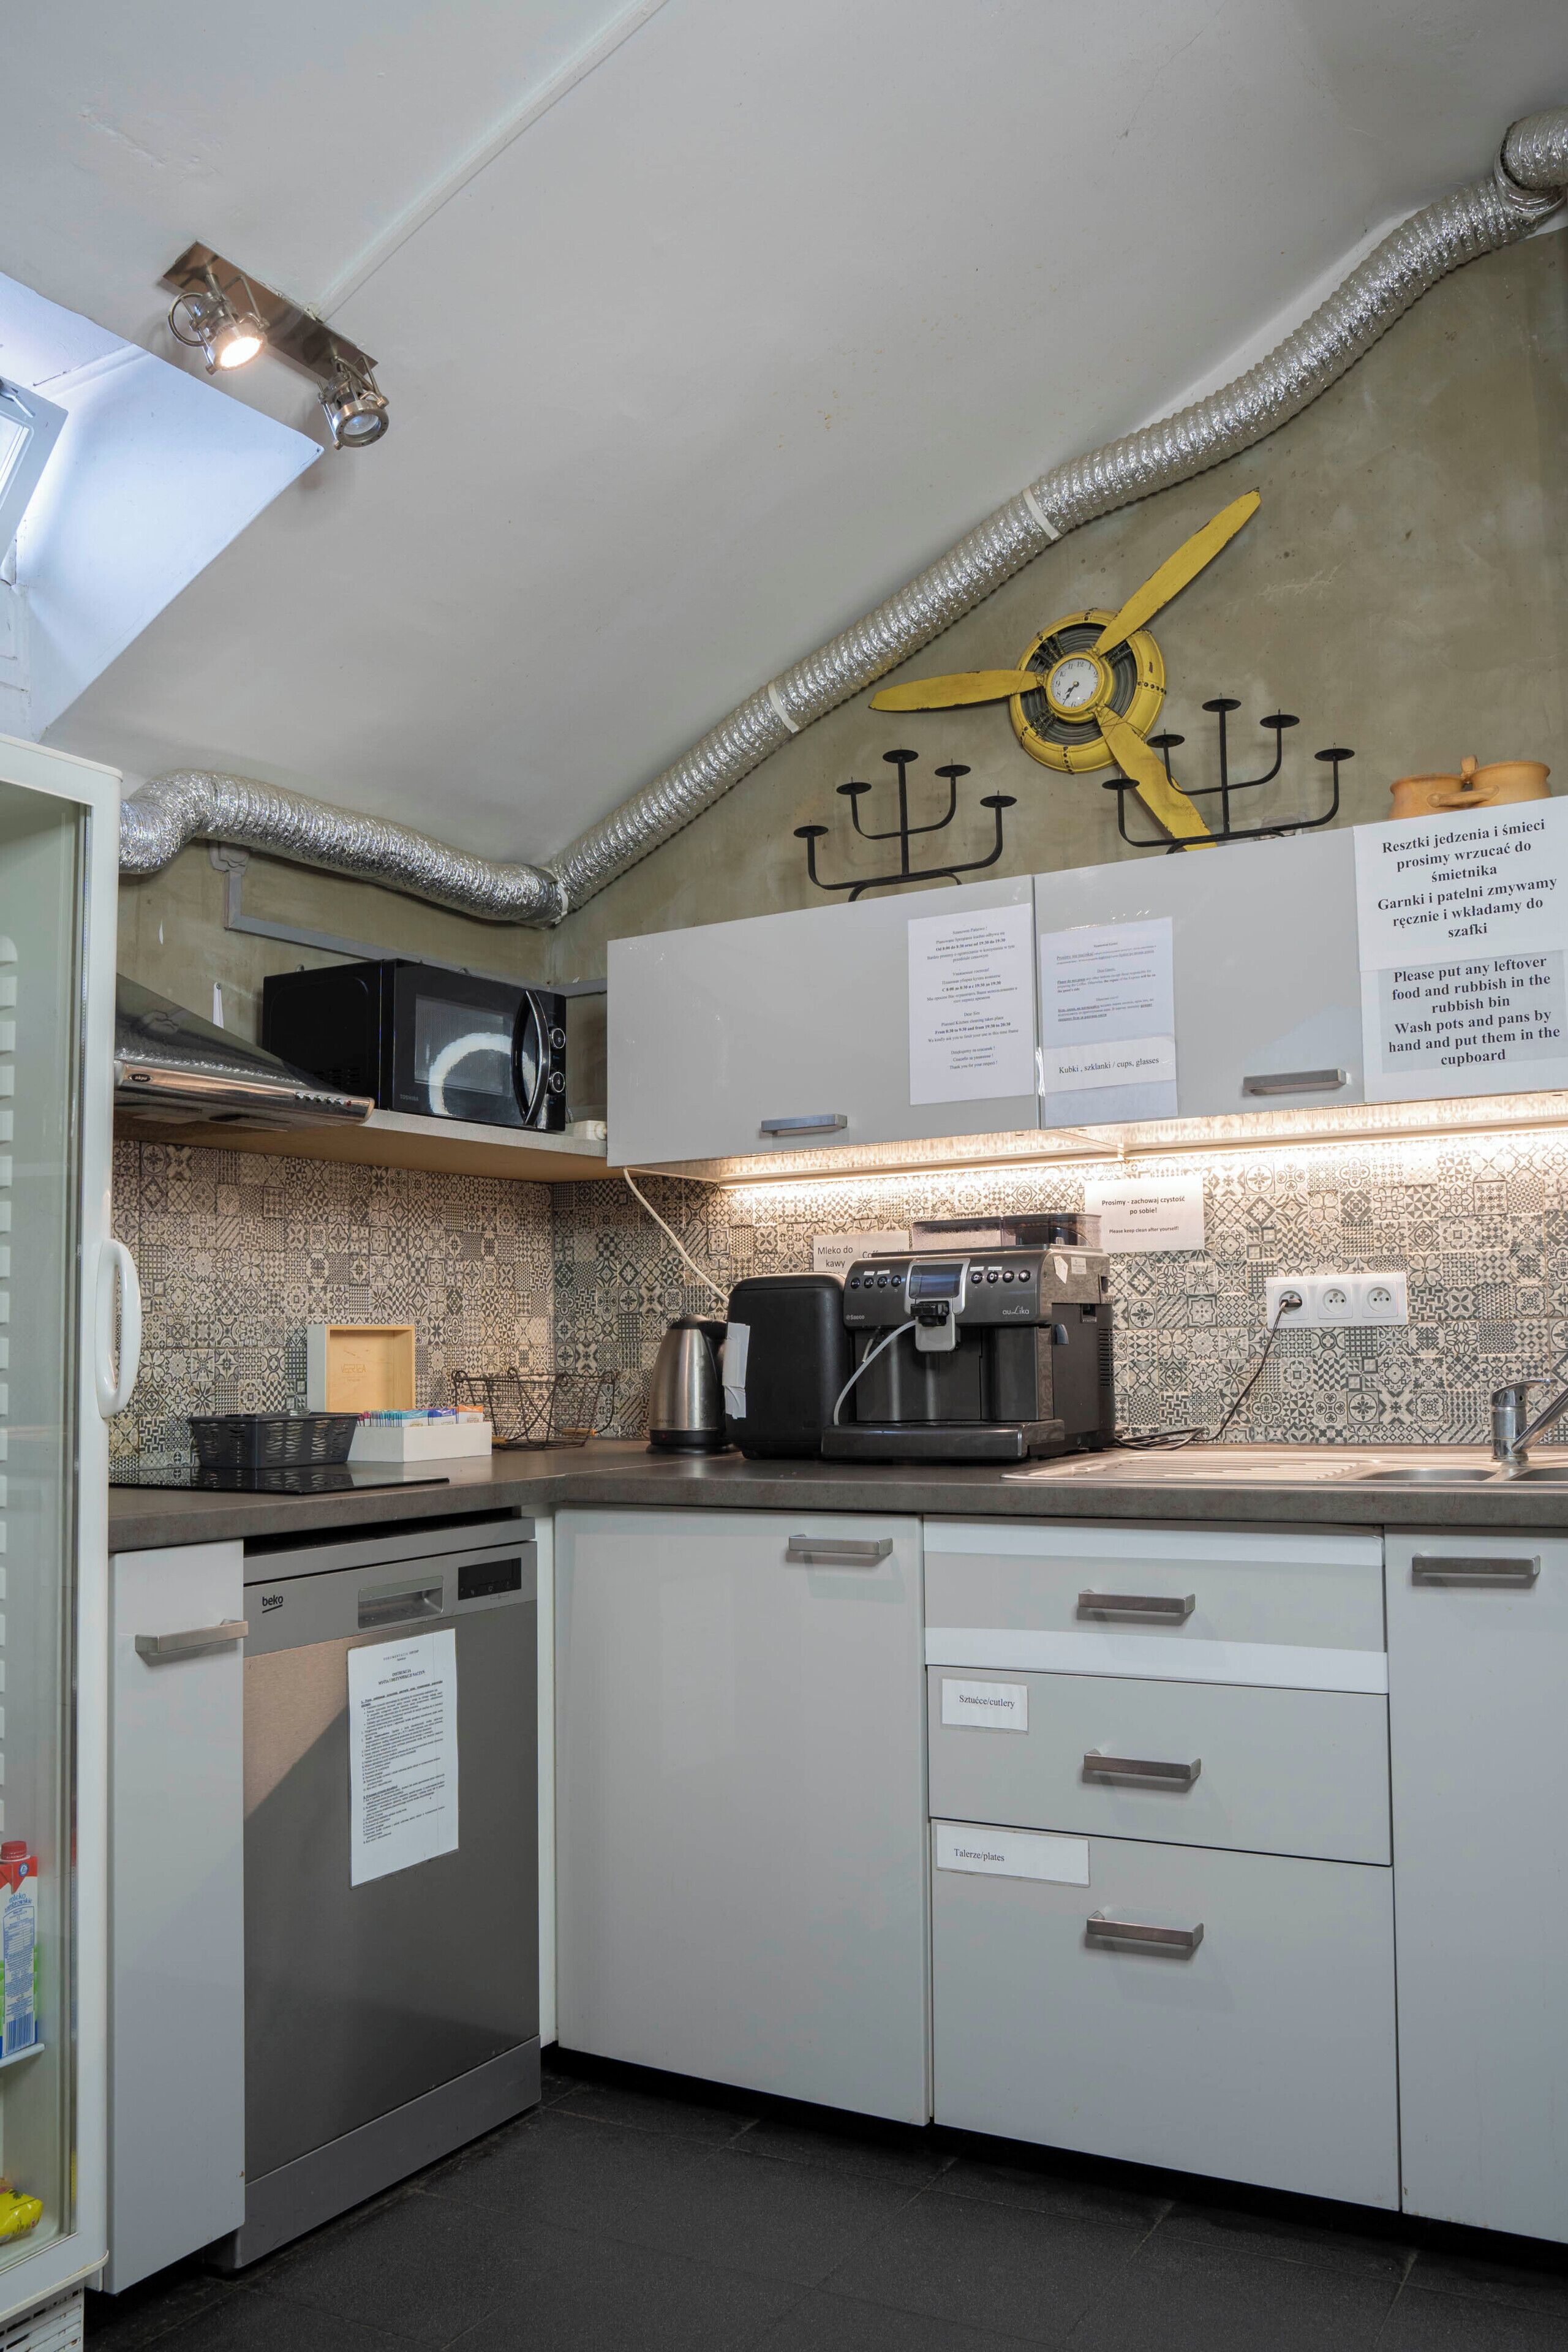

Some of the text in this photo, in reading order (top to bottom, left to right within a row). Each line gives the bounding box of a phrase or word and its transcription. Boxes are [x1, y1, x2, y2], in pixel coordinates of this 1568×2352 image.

[1382, 819, 1545, 853] Resztki jedzenia i śmieci
[1396, 840, 1531, 873] prosimy wrzucać do
[1431, 865, 1497, 883] śmietnika
[1378, 878, 1557, 910] Garnki i patelni zmywamy
[1393, 897, 1543, 929] ręcznie i wkładamy do
[1448, 922, 1487, 938] szafki
[1394, 958, 1547, 983] Please put any leftover
[1392, 974, 1550, 1000] food and rubbish in the
[1432, 995, 1510, 1014] rubbish bin
[1395, 1010, 1551, 1034] Wash pots and pans by
[1389, 1027, 1560, 1053] hand and put them in the
[1059, 1065, 1079, 1074] Kubki
[1084, 1061, 1111, 1071] szklanki
[1136, 1058, 1159, 1068] glasses
[1441, 1049, 1506, 1067] cupboard
[818, 1245, 853, 1255] Mleko do
[826, 1259, 845, 1268] kawy
[262, 1595, 284, 1607] beko
[959, 1695, 1015, 1709] Sztućce/cutlery
[954, 1848, 1005, 1861] Talerze/plates
